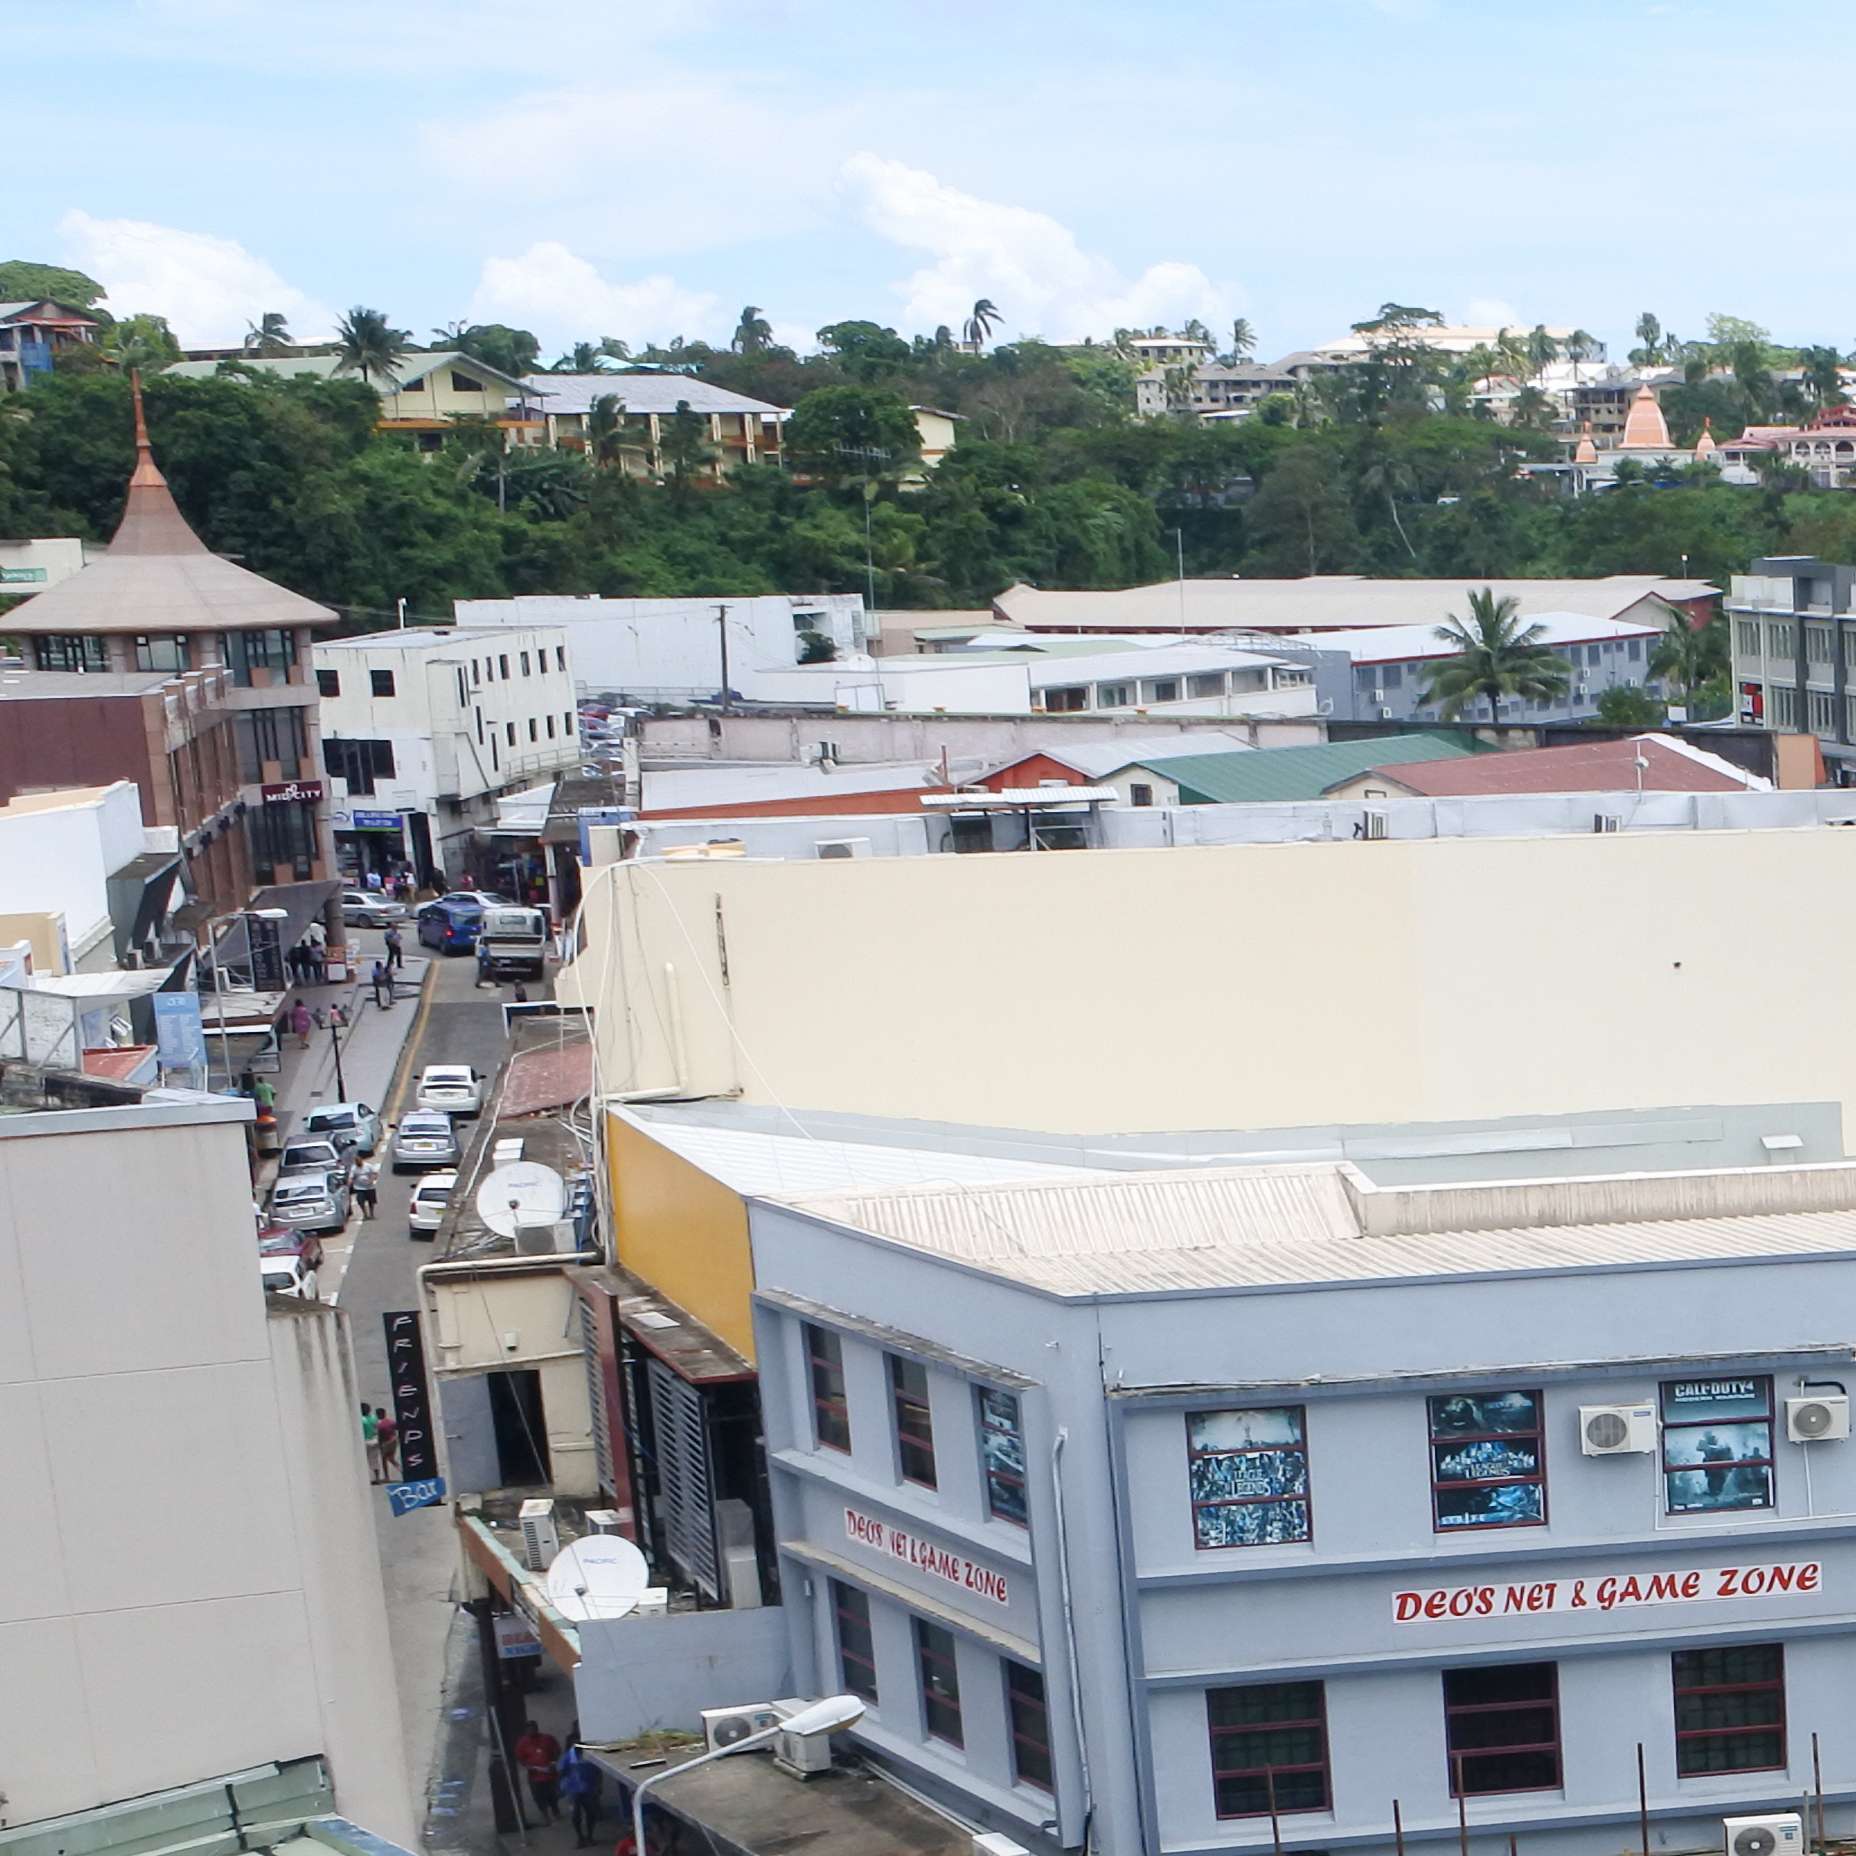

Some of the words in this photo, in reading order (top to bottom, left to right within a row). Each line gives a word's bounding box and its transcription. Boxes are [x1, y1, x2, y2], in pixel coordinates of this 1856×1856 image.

[1674, 1384, 1706, 1398] CALL
[919, 1541, 960, 1583] GAME
[964, 1561, 1008, 1602] ZONE
[1395, 1585, 1496, 1622] DEO'S
[1504, 1582, 1558, 1613] NET
[1570, 1580, 1587, 1608] &
[1597, 1570, 1701, 1610] GAME
[1717, 1563, 1819, 1597] ZONE
